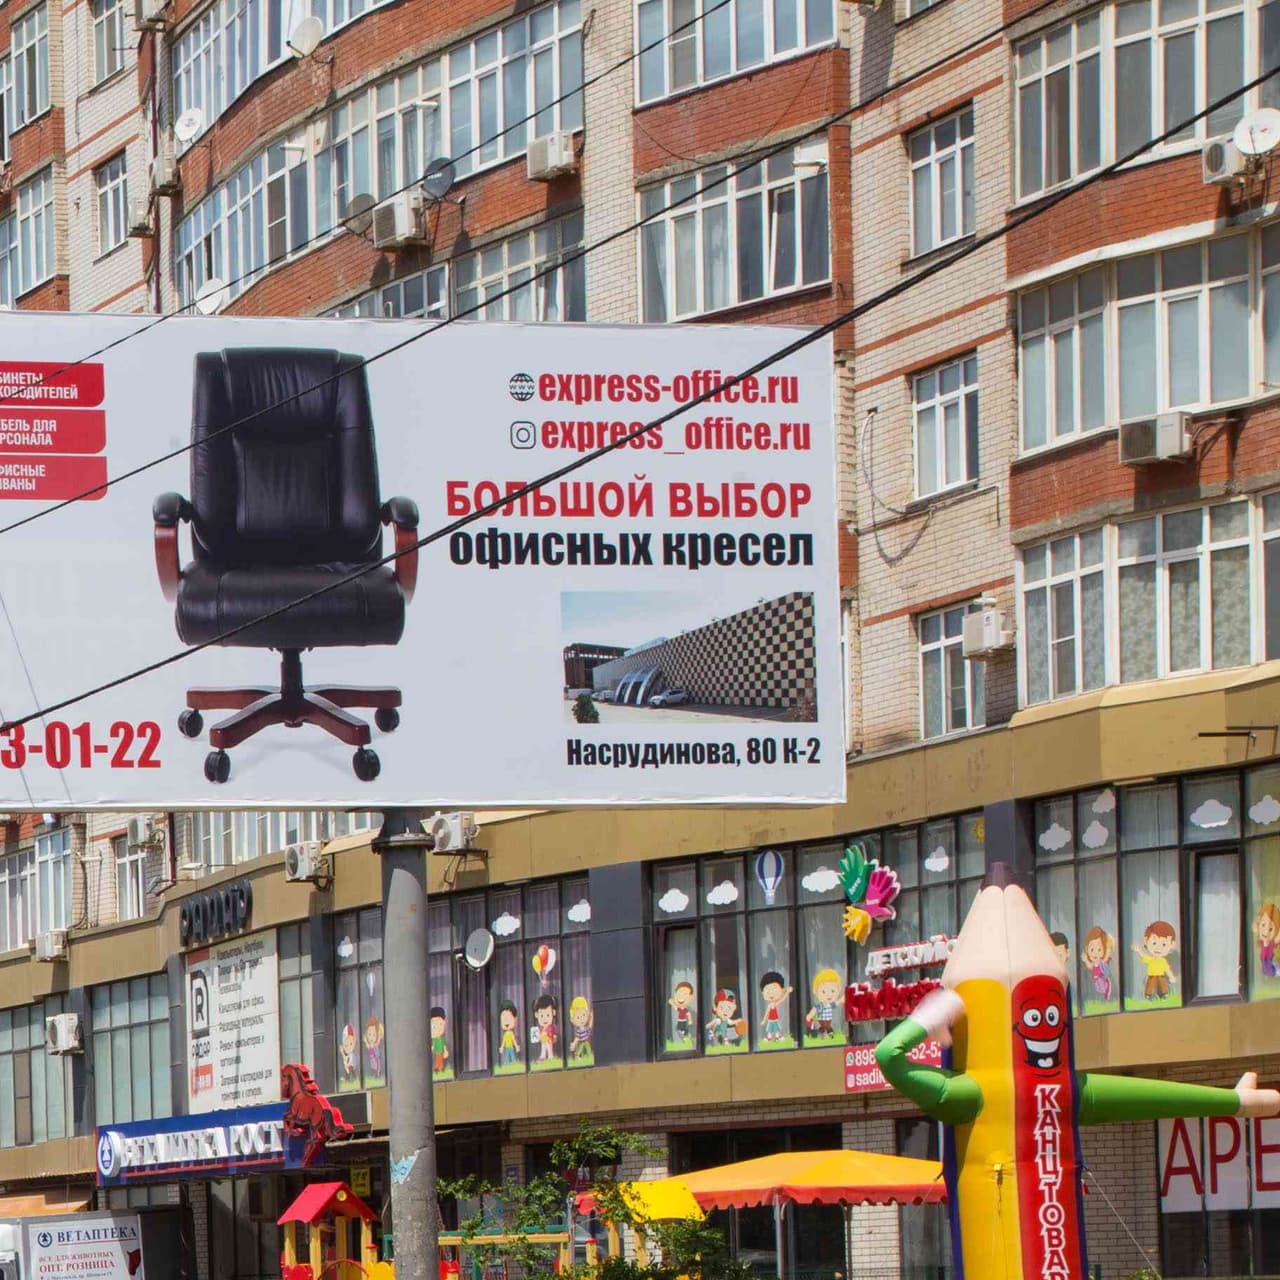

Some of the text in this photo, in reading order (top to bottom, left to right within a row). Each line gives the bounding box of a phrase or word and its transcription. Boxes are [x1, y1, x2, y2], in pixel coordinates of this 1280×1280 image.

[538, 370, 799, 405] express-office.ru
[32, 419, 57, 433] ДЛЯ
[541, 416, 810, 455] express_office.ru
[446, 473, 811, 518] БОЛЬШОЙ ВЫБОР
[450, 527, 813, 570] офисных кресел
[567, 737, 820, 769] Насрудинова, 80 К-2
[855, 1049, 877, 1067] 898
[58, 1227, 137, 1243] ВЕТАПТЕКА
